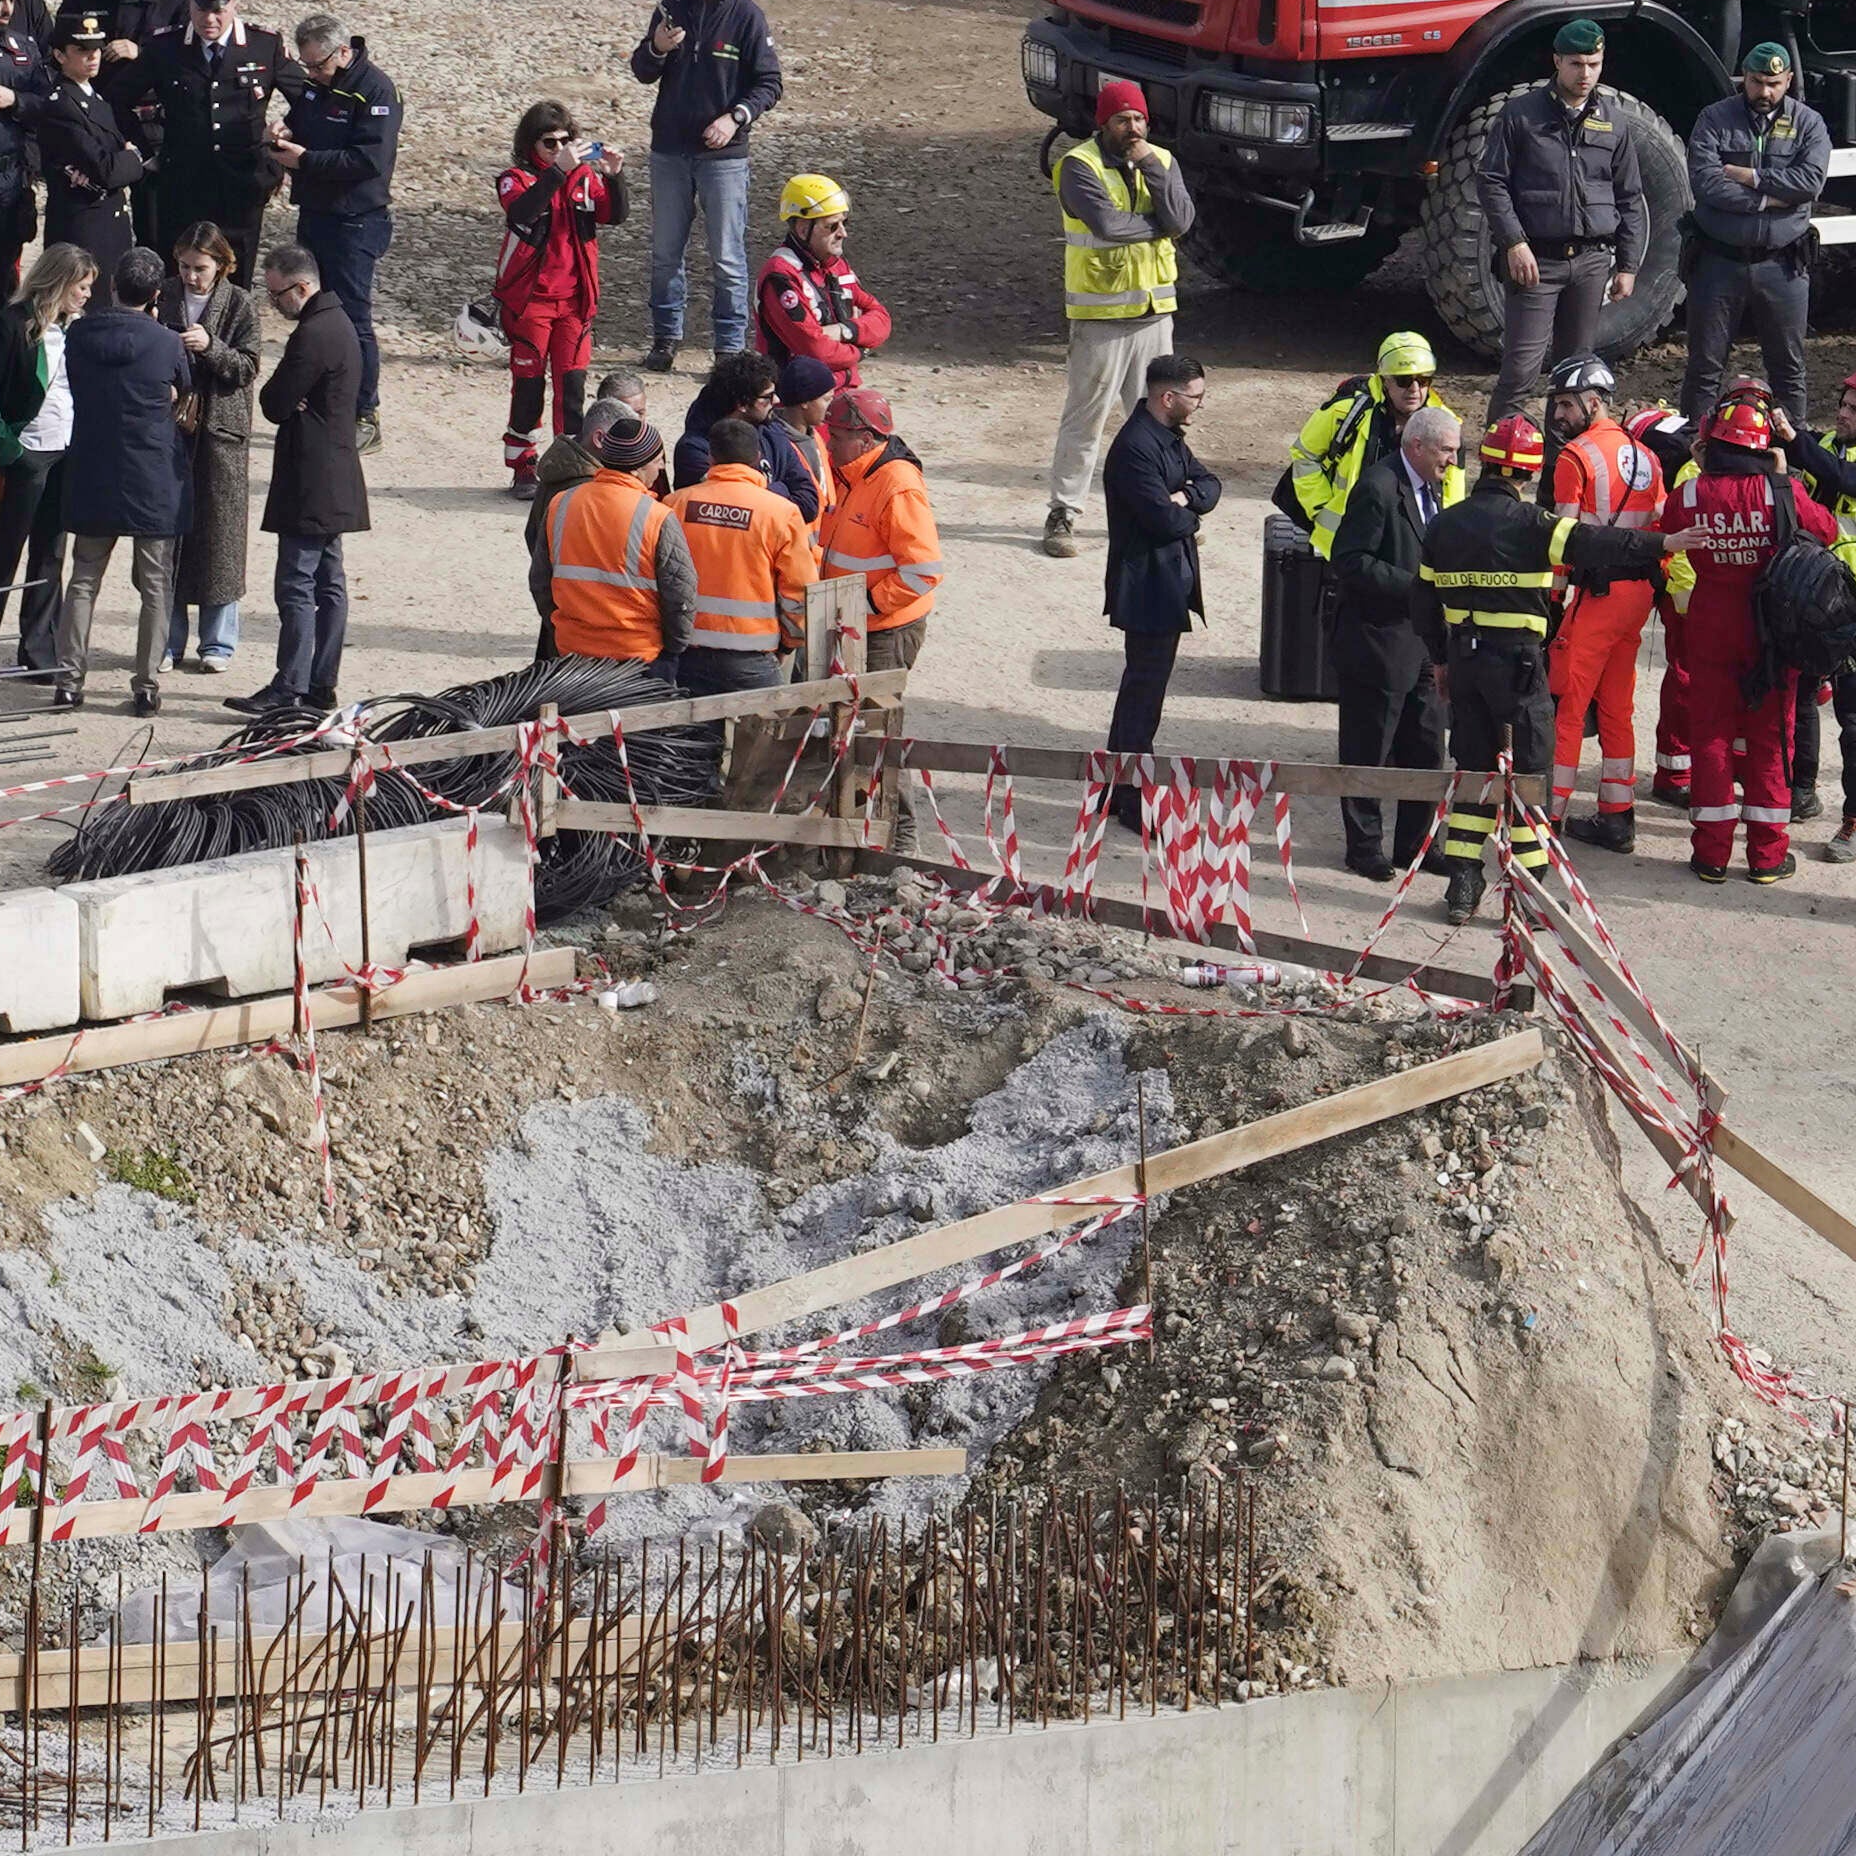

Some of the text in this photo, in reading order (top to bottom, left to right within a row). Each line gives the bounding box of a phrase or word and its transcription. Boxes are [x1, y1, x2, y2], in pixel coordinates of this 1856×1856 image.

[699, 504, 751, 523] CARRON
[1706, 536, 1772, 550] OSCANA
[1461, 573, 1479, 585] DEL
[1480, 573, 1518, 585] FUOCO
